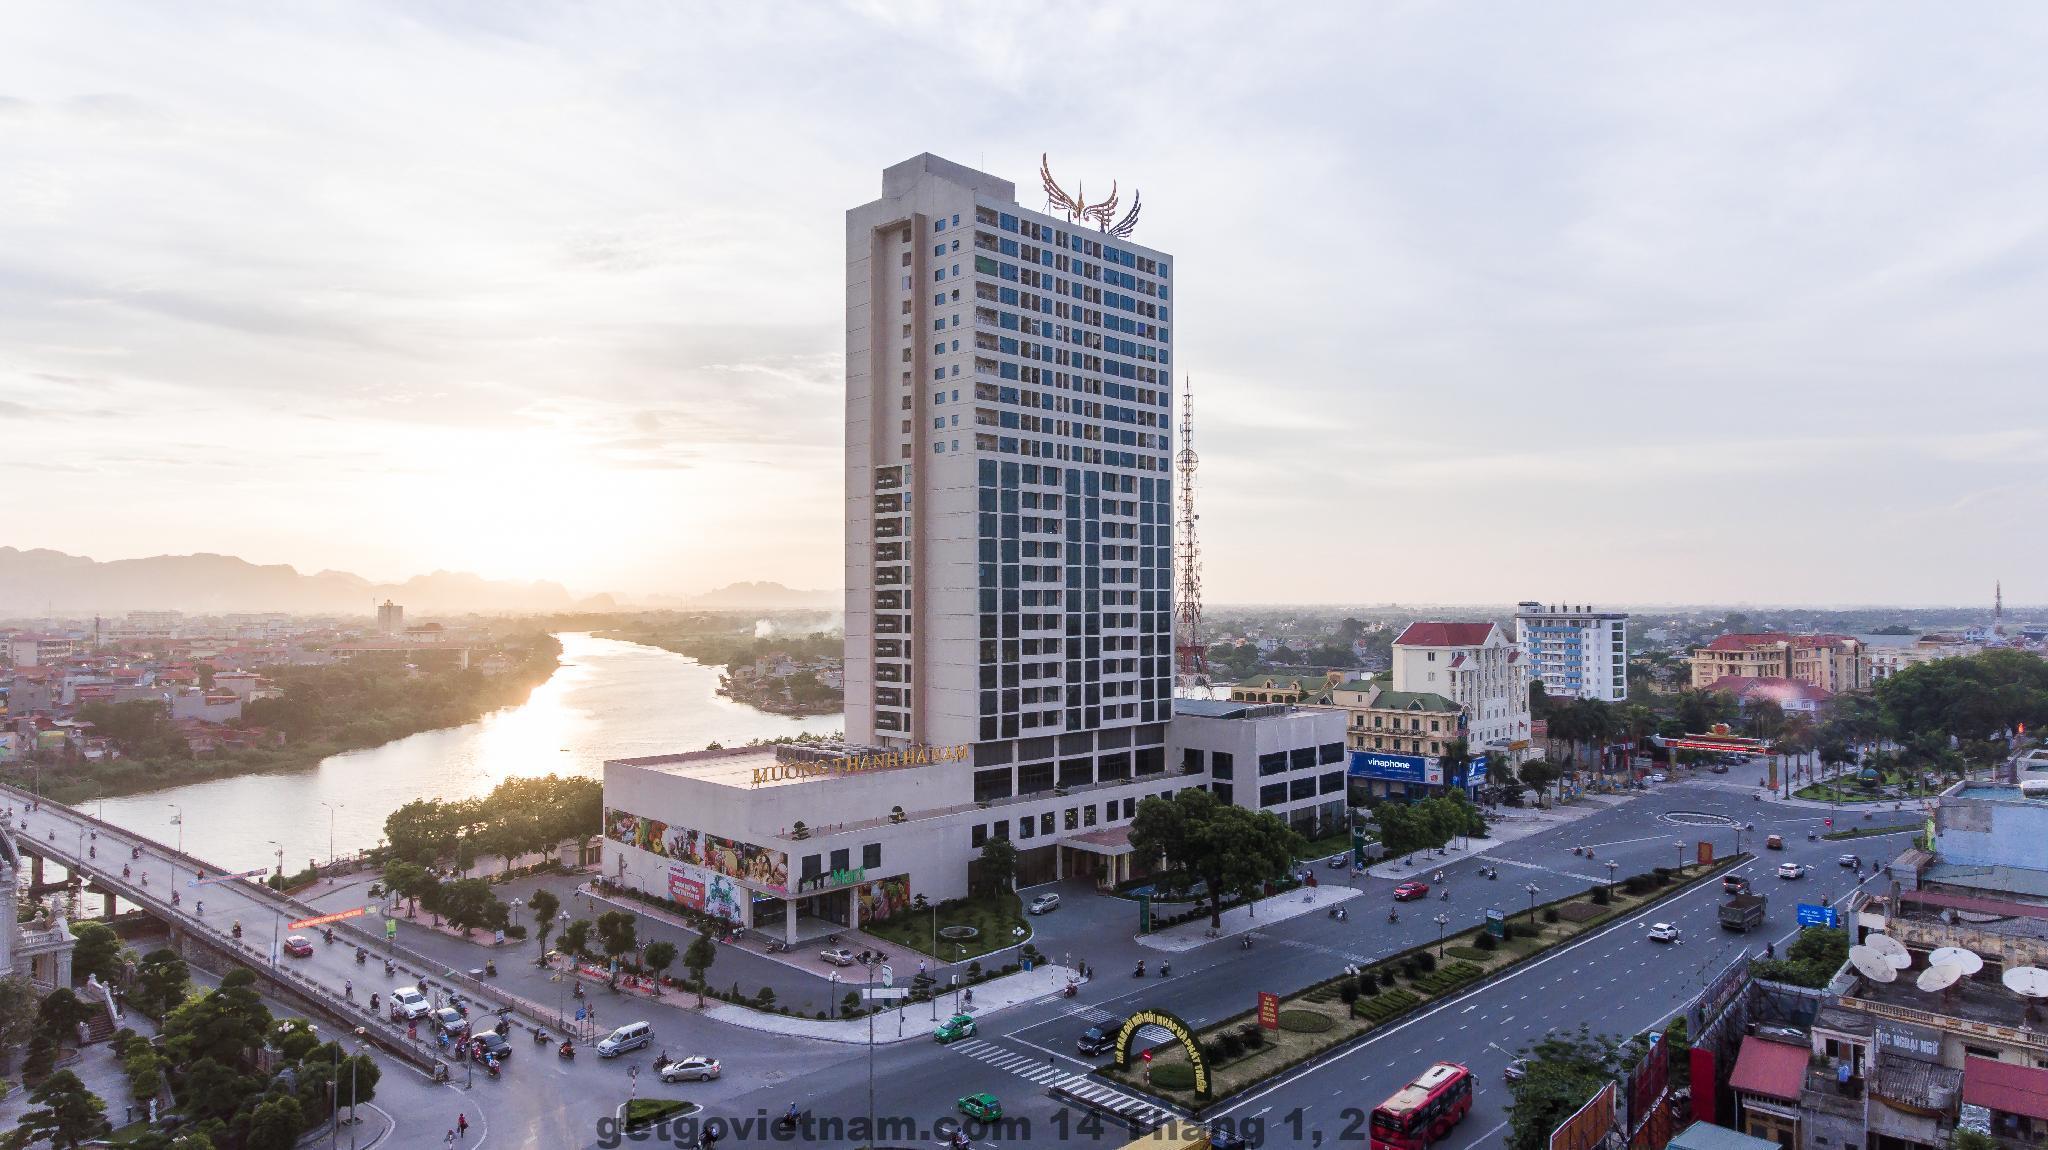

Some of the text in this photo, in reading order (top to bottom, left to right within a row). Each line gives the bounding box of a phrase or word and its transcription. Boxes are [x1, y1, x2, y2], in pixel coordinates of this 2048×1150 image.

[832, 751, 898, 776] THANH
[1367, 757, 1410, 769] vinaphone
[832, 866, 865, 886] Mart
